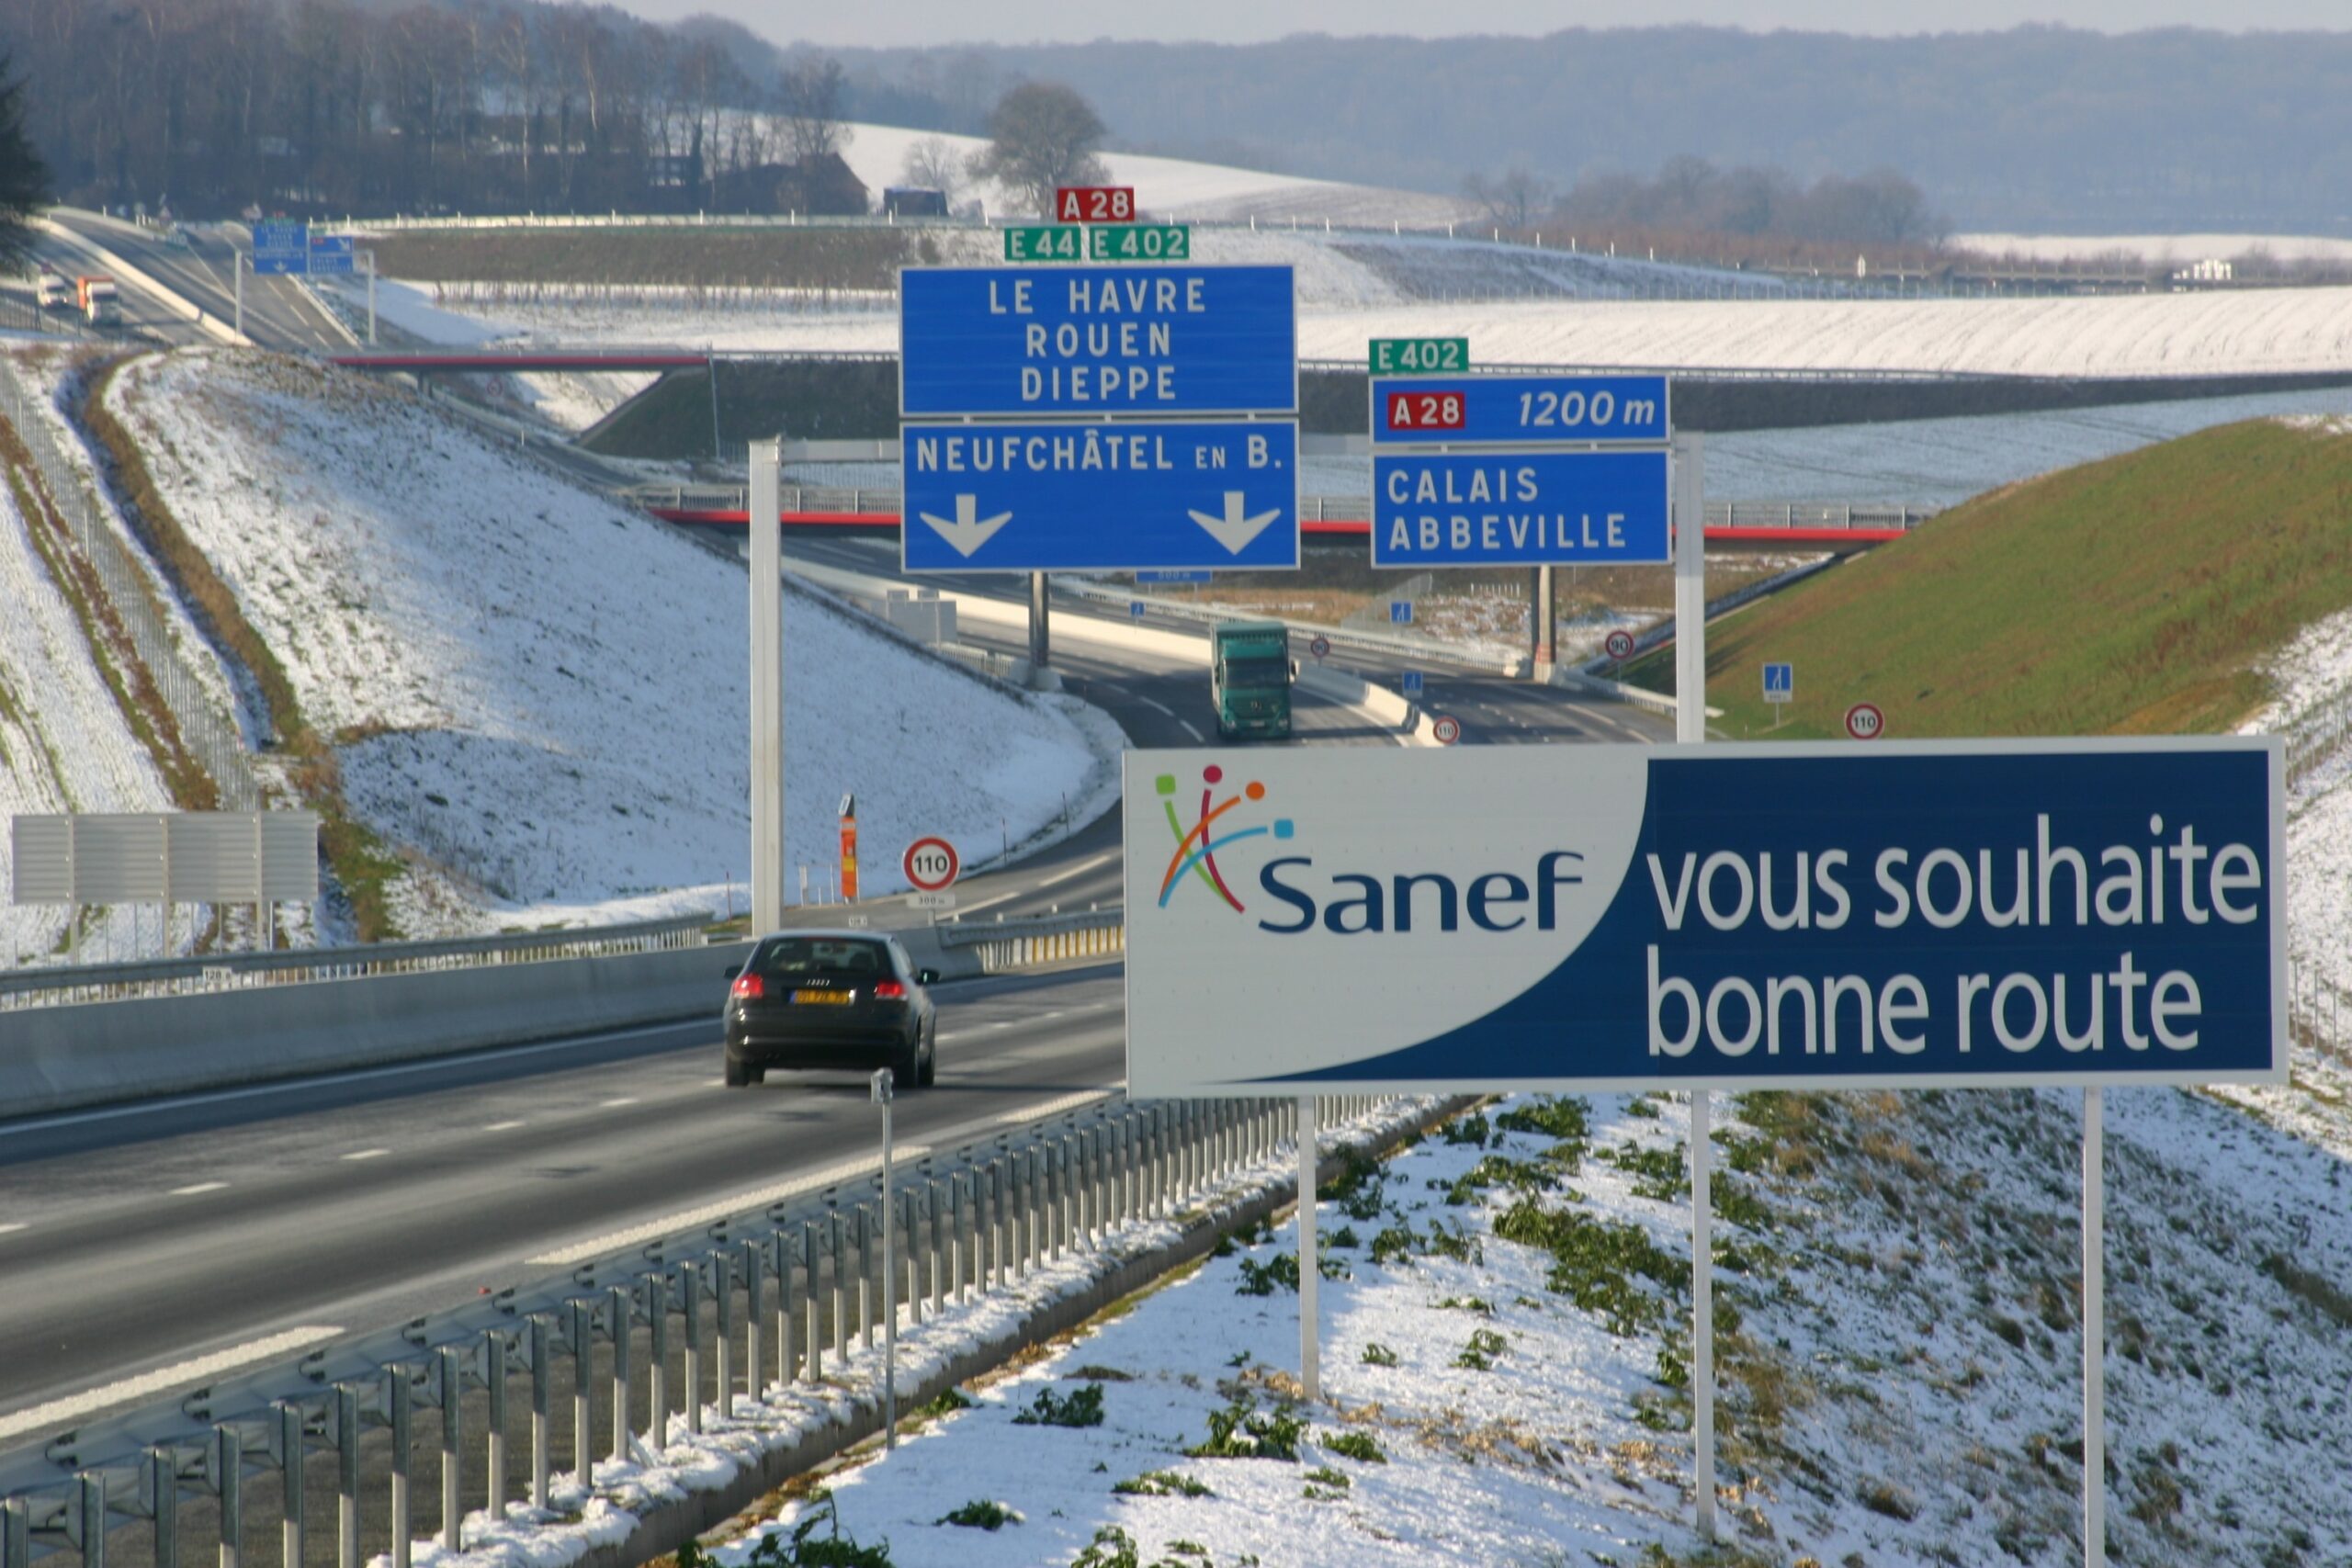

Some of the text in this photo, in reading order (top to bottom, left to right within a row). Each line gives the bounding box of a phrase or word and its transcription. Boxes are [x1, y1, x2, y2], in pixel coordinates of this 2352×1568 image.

[1063, 191, 1129, 218] A 28
[1011, 231, 1074, 257] E 44
[1094, 230, 1184, 256] E 402
[989, 278, 1205, 314] LE HAVRE
[1026, 322, 1170, 357] ROUEN
[1378, 342, 1459, 369] E 402
[1022, 366, 1175, 401] DIEPPE
[1394, 396, 1459, 425] A 28
[1520, 390, 1655, 426] 1200 m
[918, 429, 1282, 471] NEUFCHÂTEL EN B.
[1387, 467, 1538, 503] CALAIS
[1389, 513, 1626, 550] ABBEVILLE
[1438, 725, 1453, 737] 110
[1854, 716, 1875, 729] 110
[915, 855, 947, 873] 110
[1646, 813, 2262, 931] vous souhaite
[1259, 851, 1584, 934] Sanef
[1647, 944, 2202, 1057] bonne route
